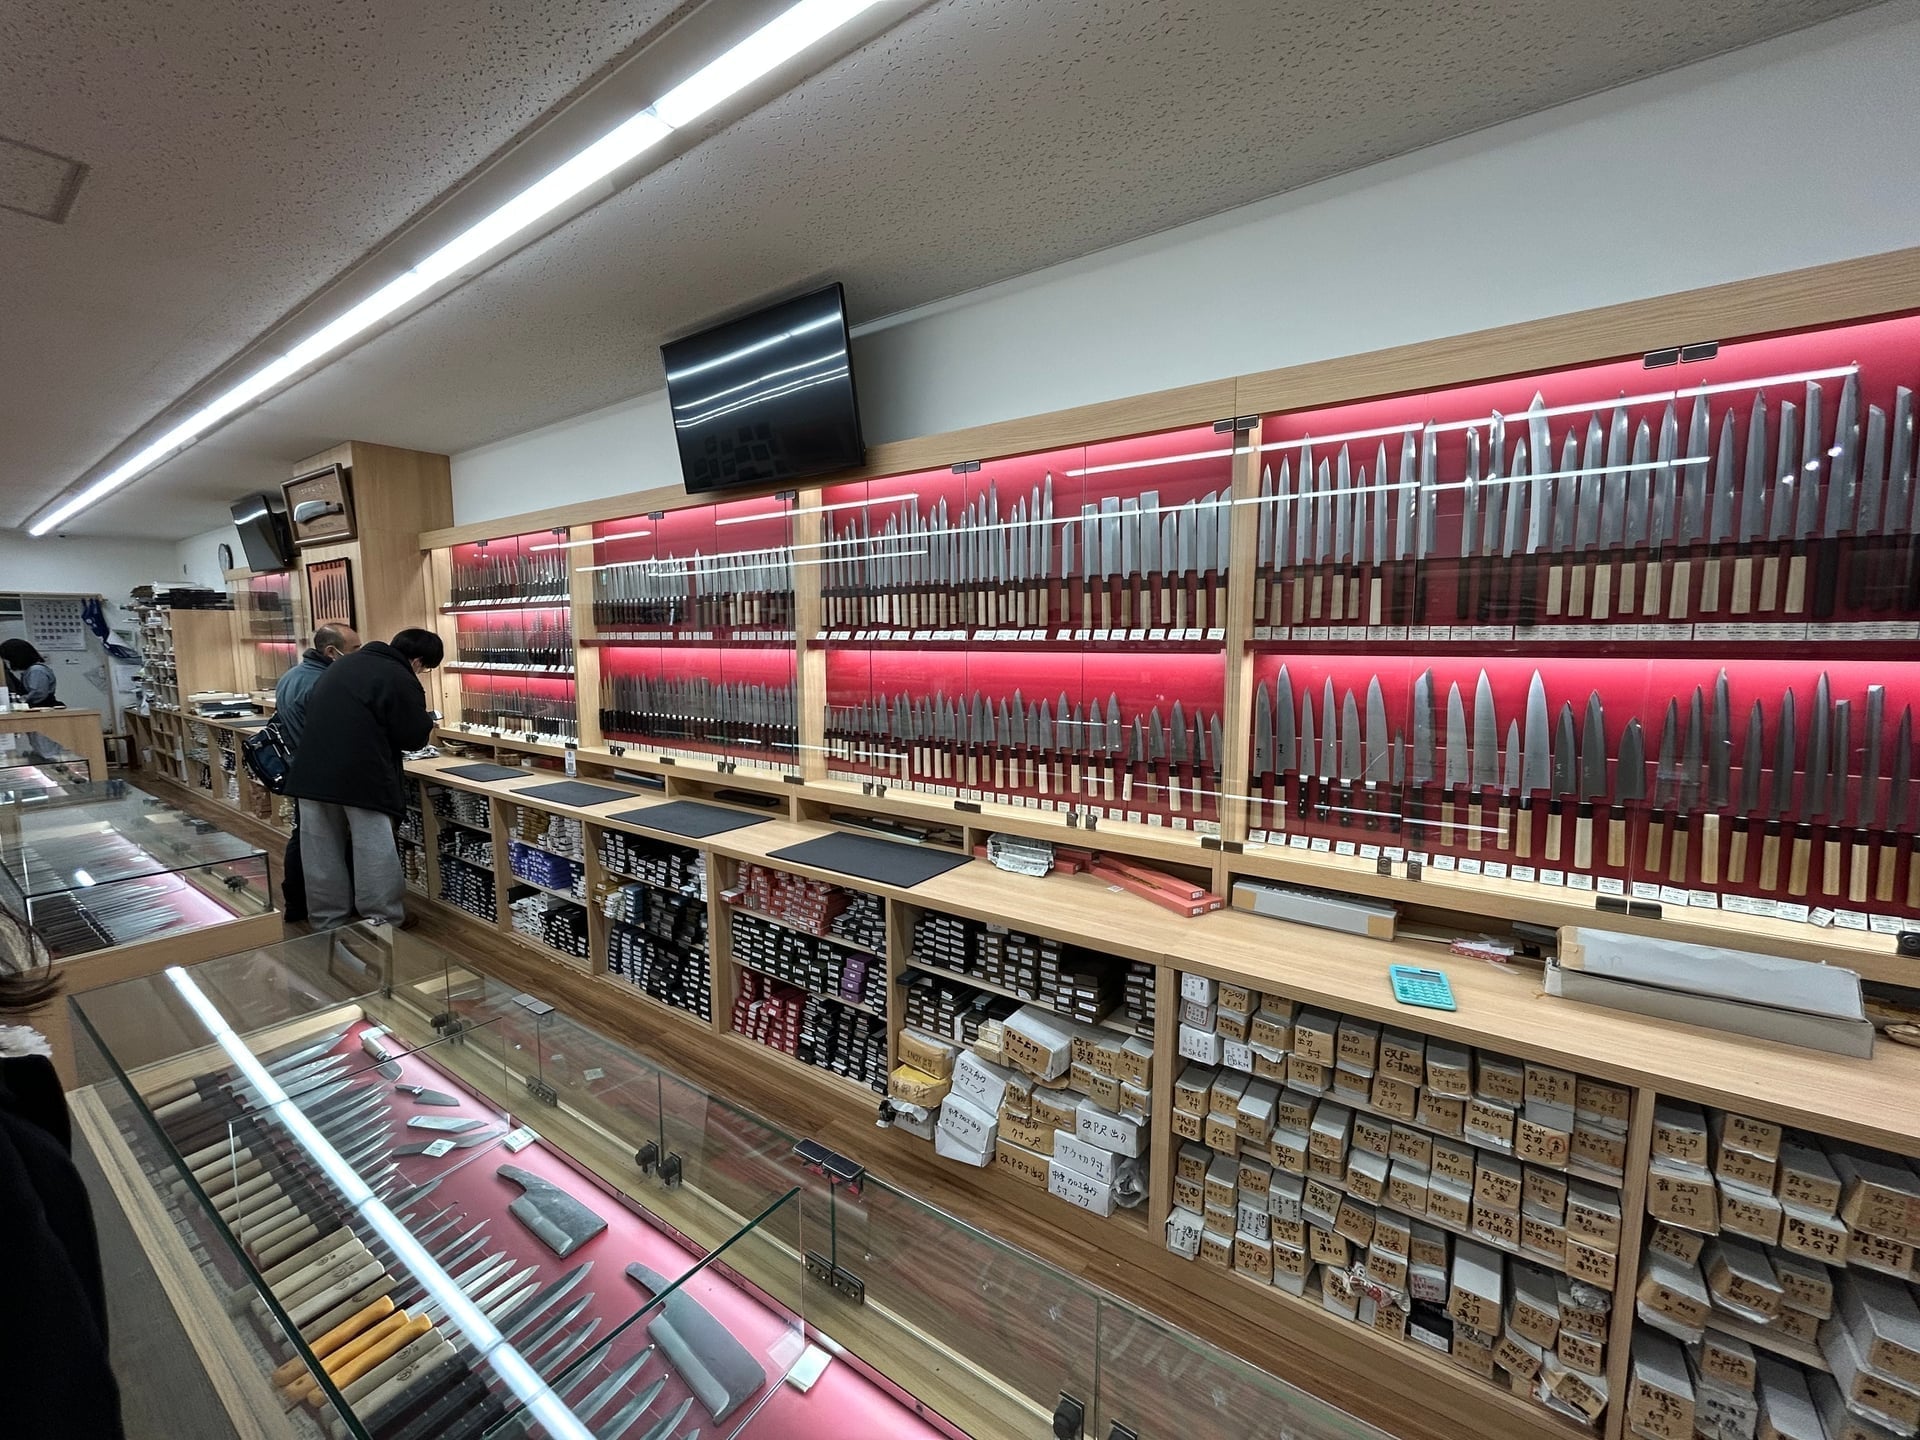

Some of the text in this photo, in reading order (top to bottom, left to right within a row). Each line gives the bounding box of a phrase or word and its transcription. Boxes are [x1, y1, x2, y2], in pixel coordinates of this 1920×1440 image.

[1740, 1135, 1763, 1149] 4寸
[1666, 1143, 1689, 1158] 5寸
[1671, 1194, 1692, 1206] 6寸
[1462, 1301, 1481, 1315] 6寸
